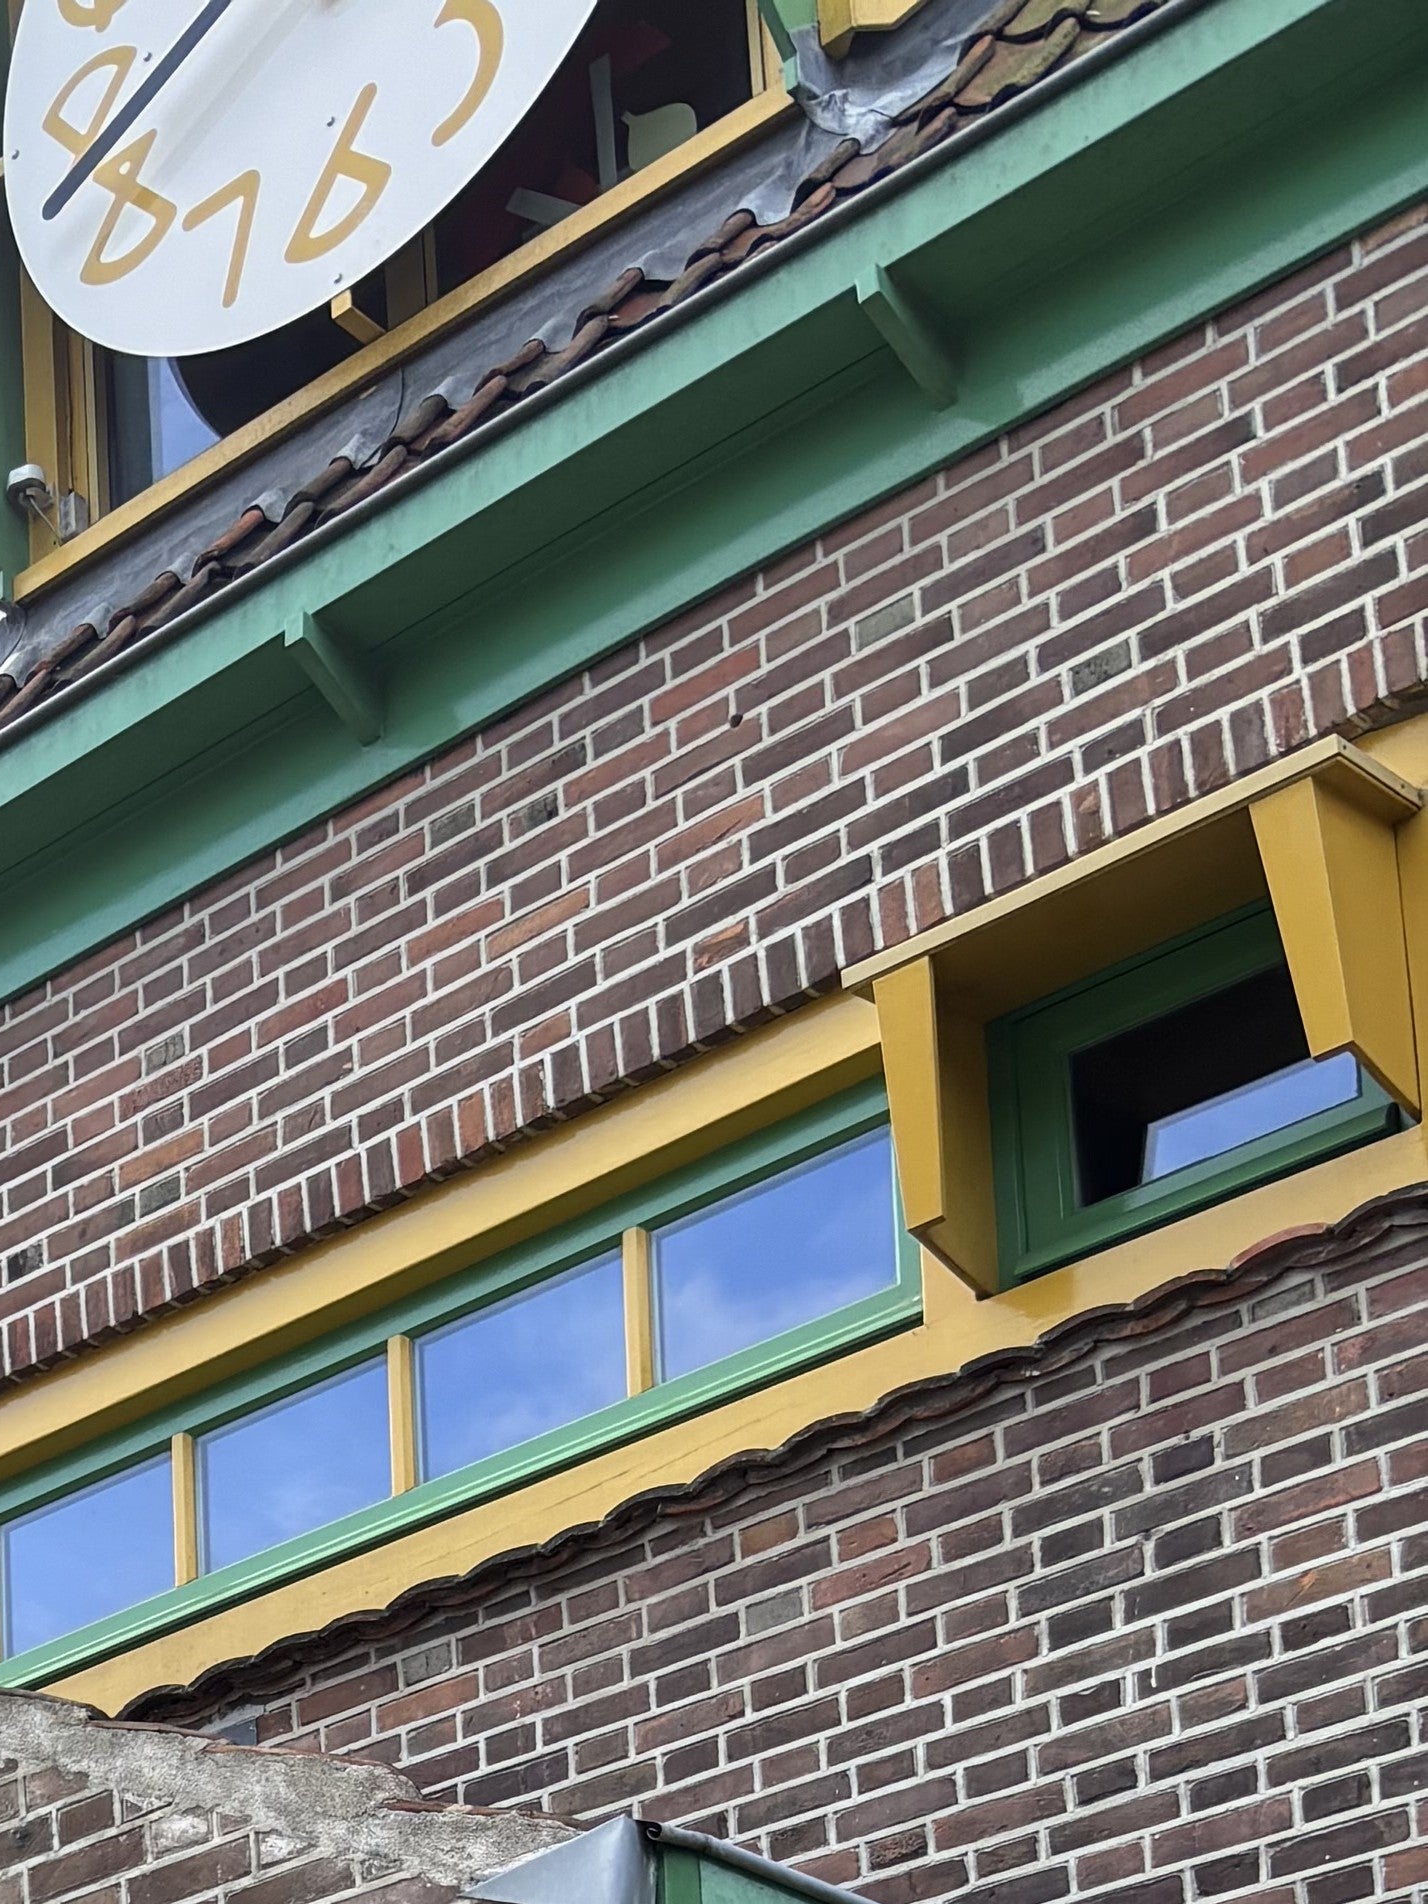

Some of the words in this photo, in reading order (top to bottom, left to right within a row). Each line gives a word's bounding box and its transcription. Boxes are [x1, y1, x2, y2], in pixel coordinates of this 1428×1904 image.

[79, 128, 178, 286] 8
[182, 169, 261, 309] 7
[284, 82, 393, 264] 6
